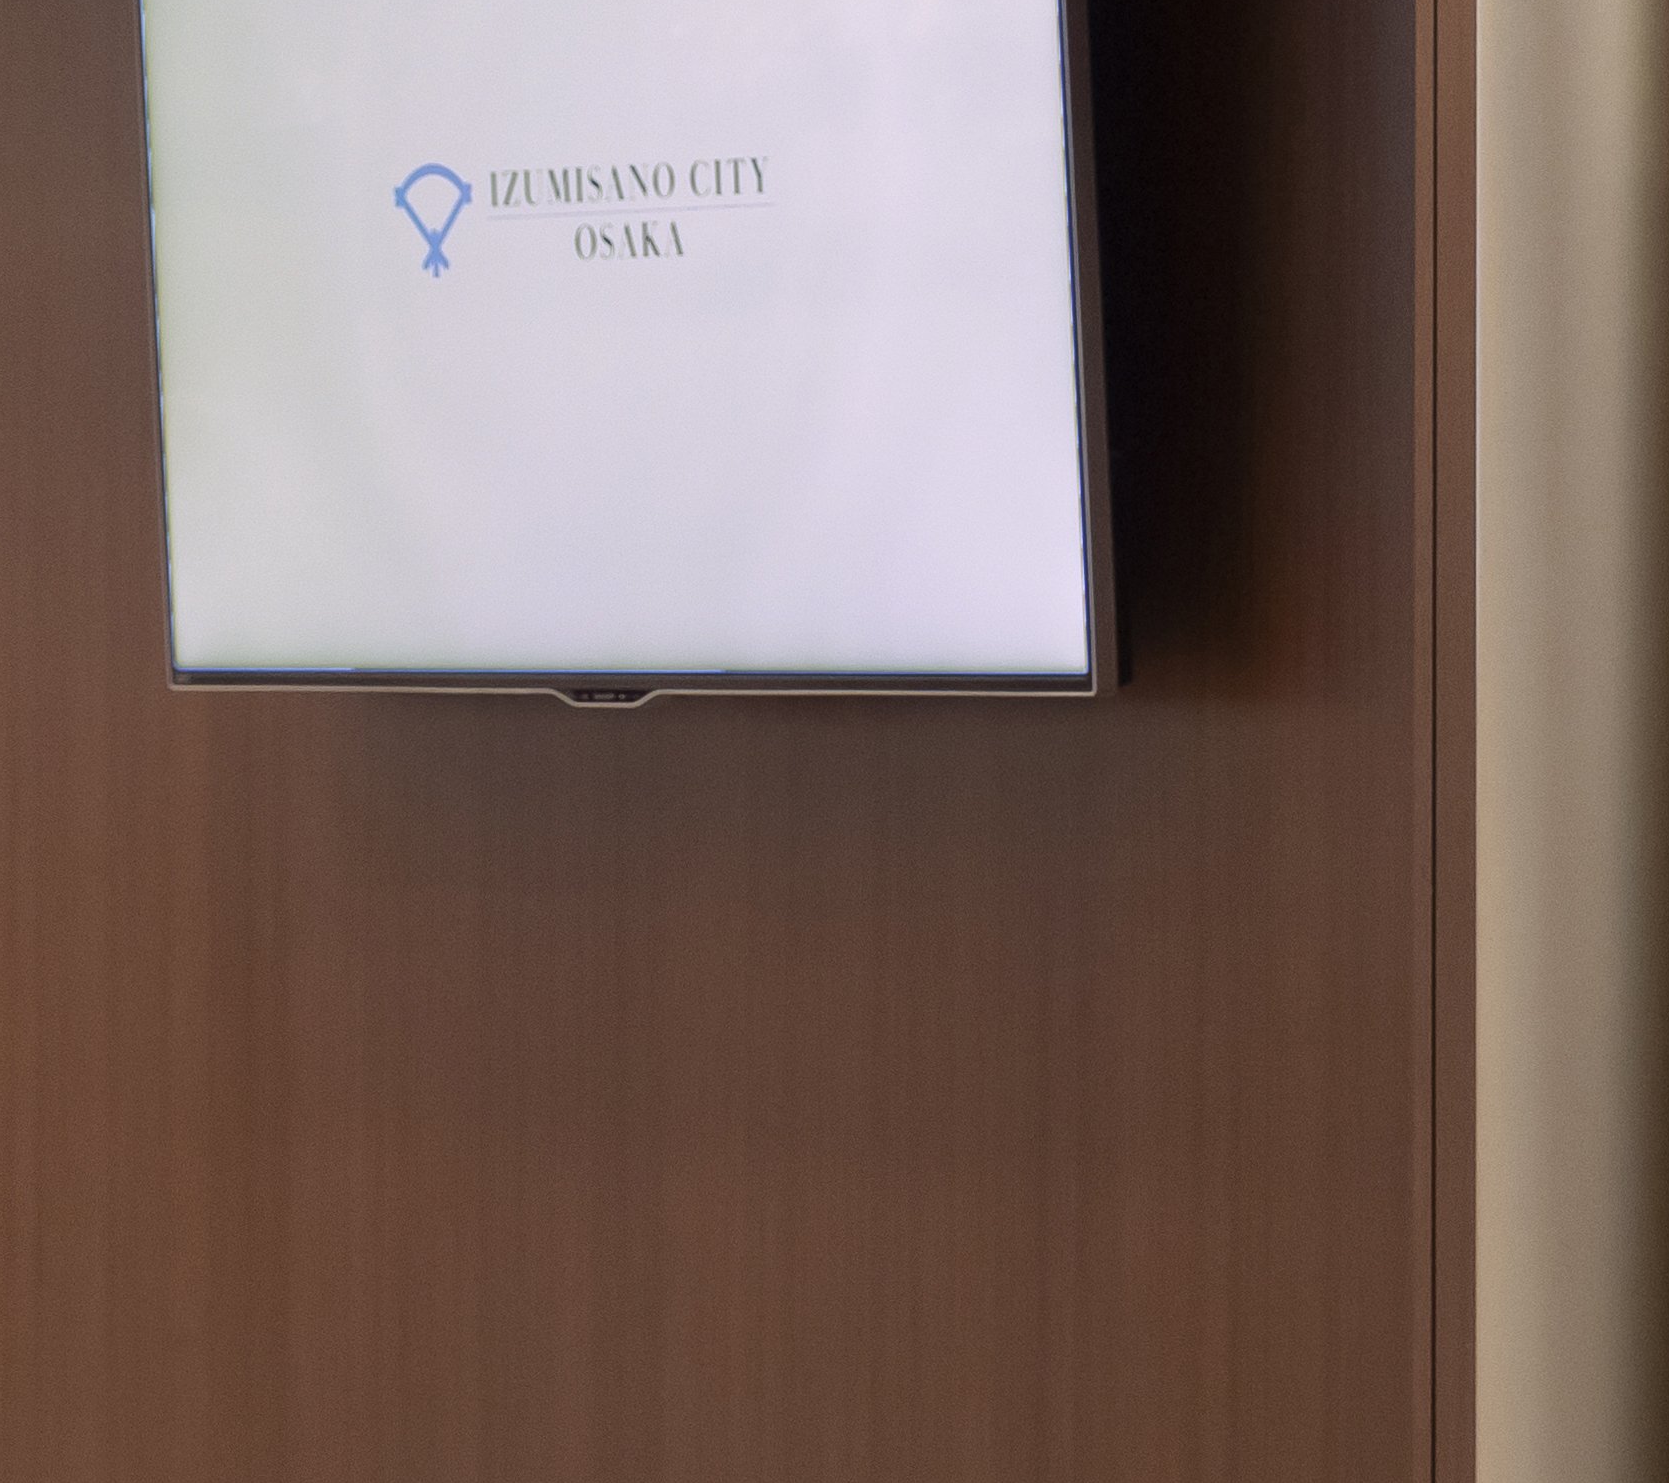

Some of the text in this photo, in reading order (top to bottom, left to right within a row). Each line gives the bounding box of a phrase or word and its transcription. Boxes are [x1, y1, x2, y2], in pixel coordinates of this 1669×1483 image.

[487, 155, 771, 209] IZUMISANO CITY
[573, 219, 685, 262] OSAKA
